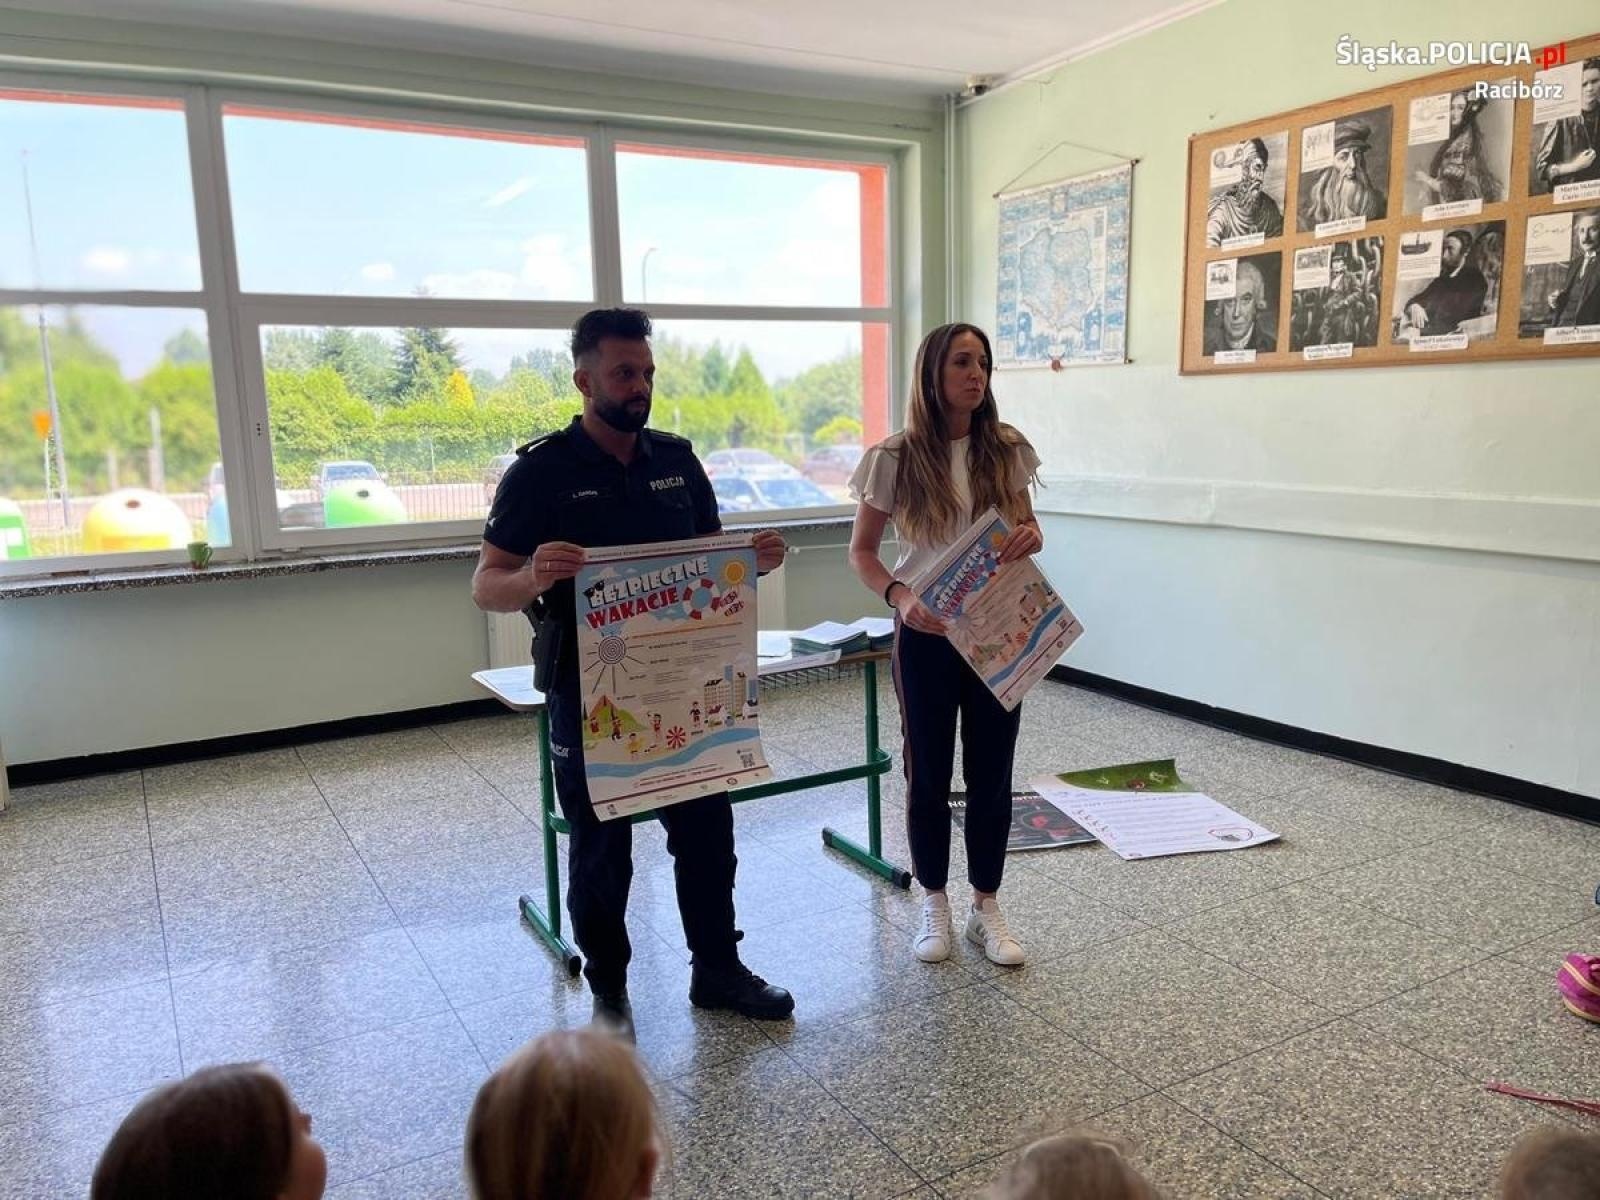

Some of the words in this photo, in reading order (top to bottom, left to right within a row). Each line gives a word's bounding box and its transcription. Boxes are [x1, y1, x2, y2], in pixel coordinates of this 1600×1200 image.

[650, 476, 685, 491] POLICJA
[586, 556, 709, 609] BEZPIECZNE
[586, 586, 680, 630] WAKACJE
